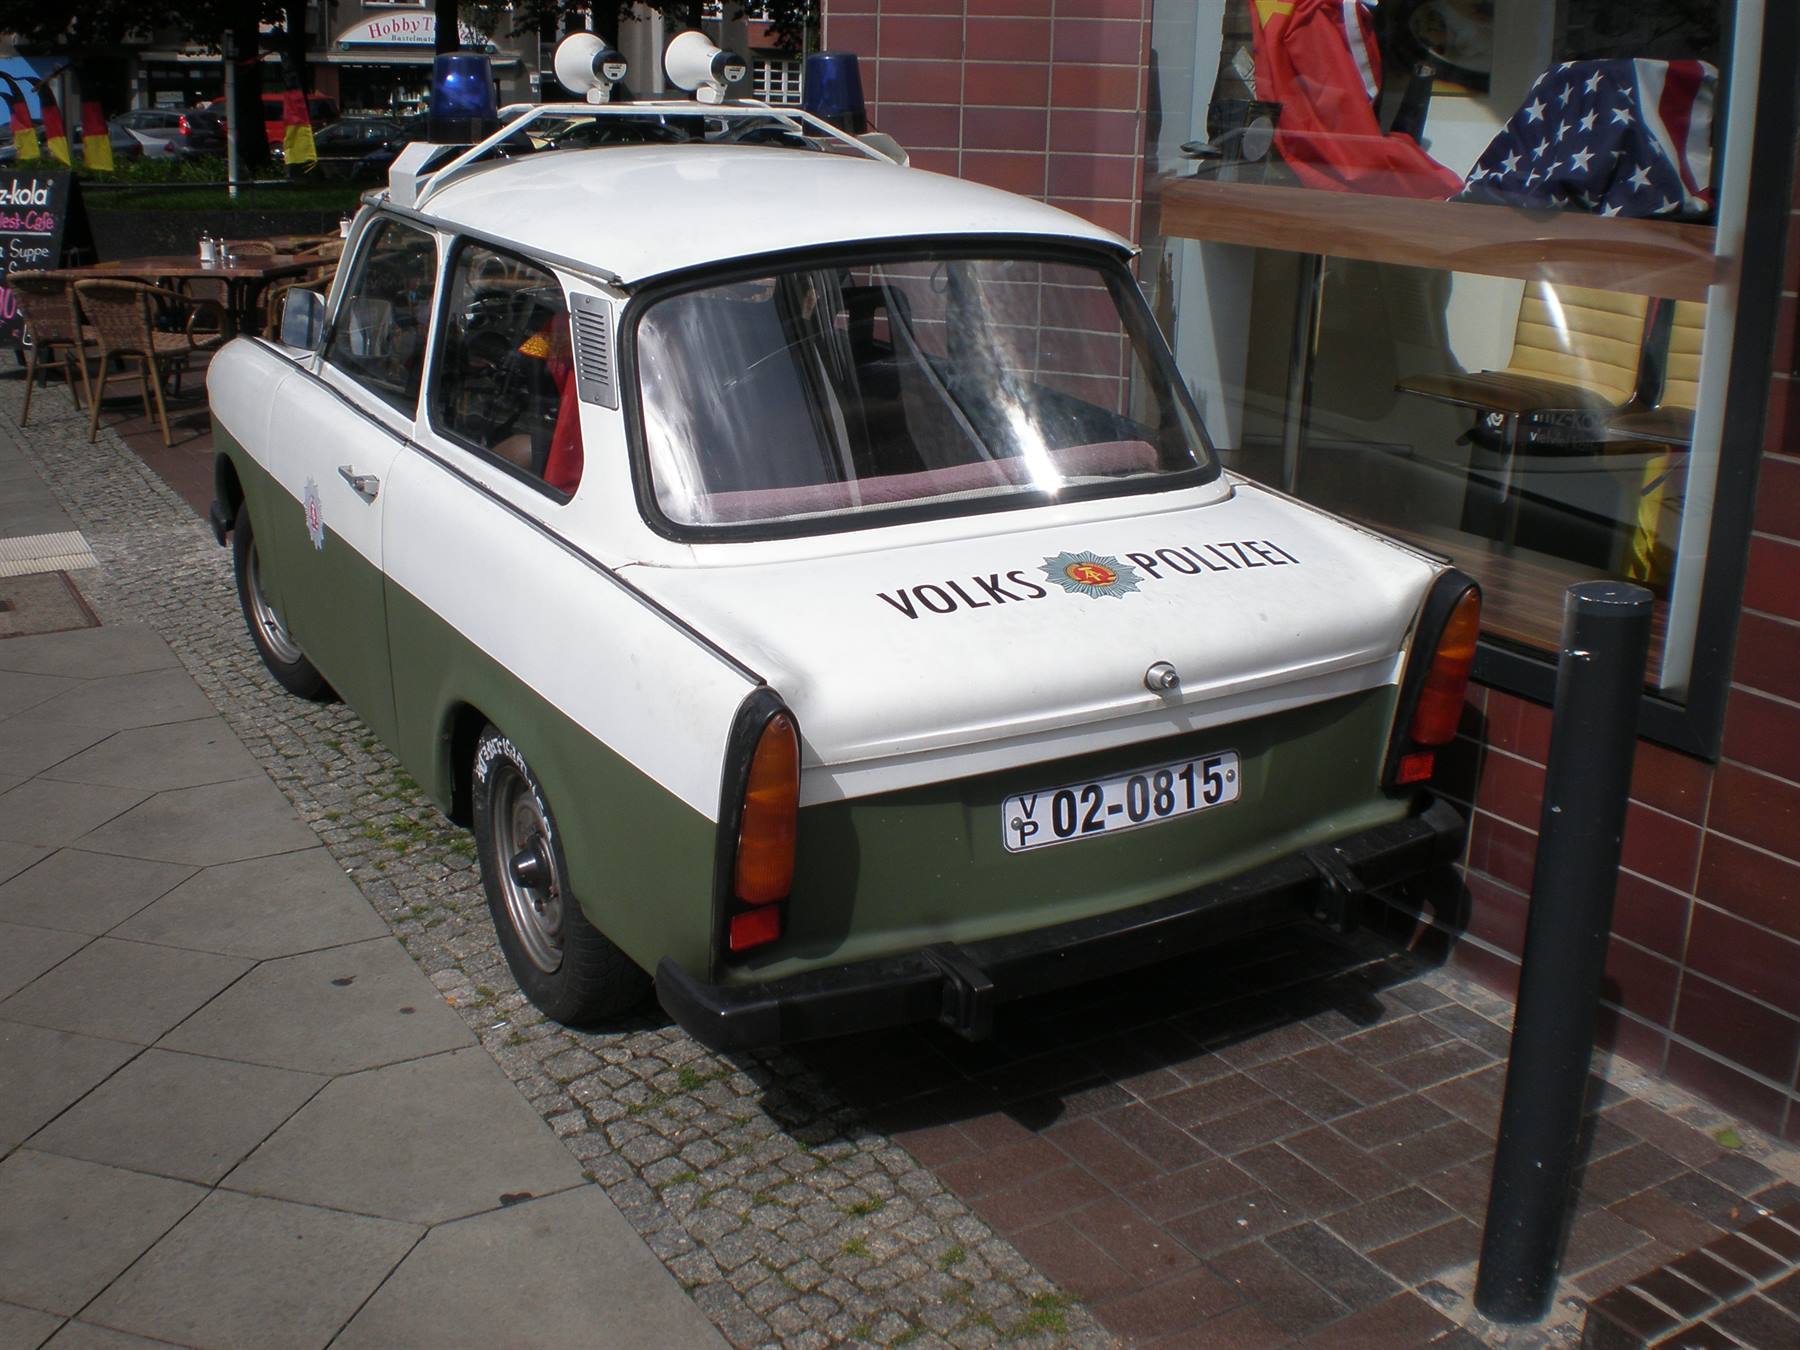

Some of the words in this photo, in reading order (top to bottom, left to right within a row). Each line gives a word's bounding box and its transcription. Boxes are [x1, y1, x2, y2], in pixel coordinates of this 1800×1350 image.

[368, 17, 420, 38] Hobby
[10, 238, 49, 262] Suppe
[876, 570, 1047, 619] VOLKS
[1126, 540, 1300, 579] POLIZEI
[1052, 757, 1223, 838] 02-0815
